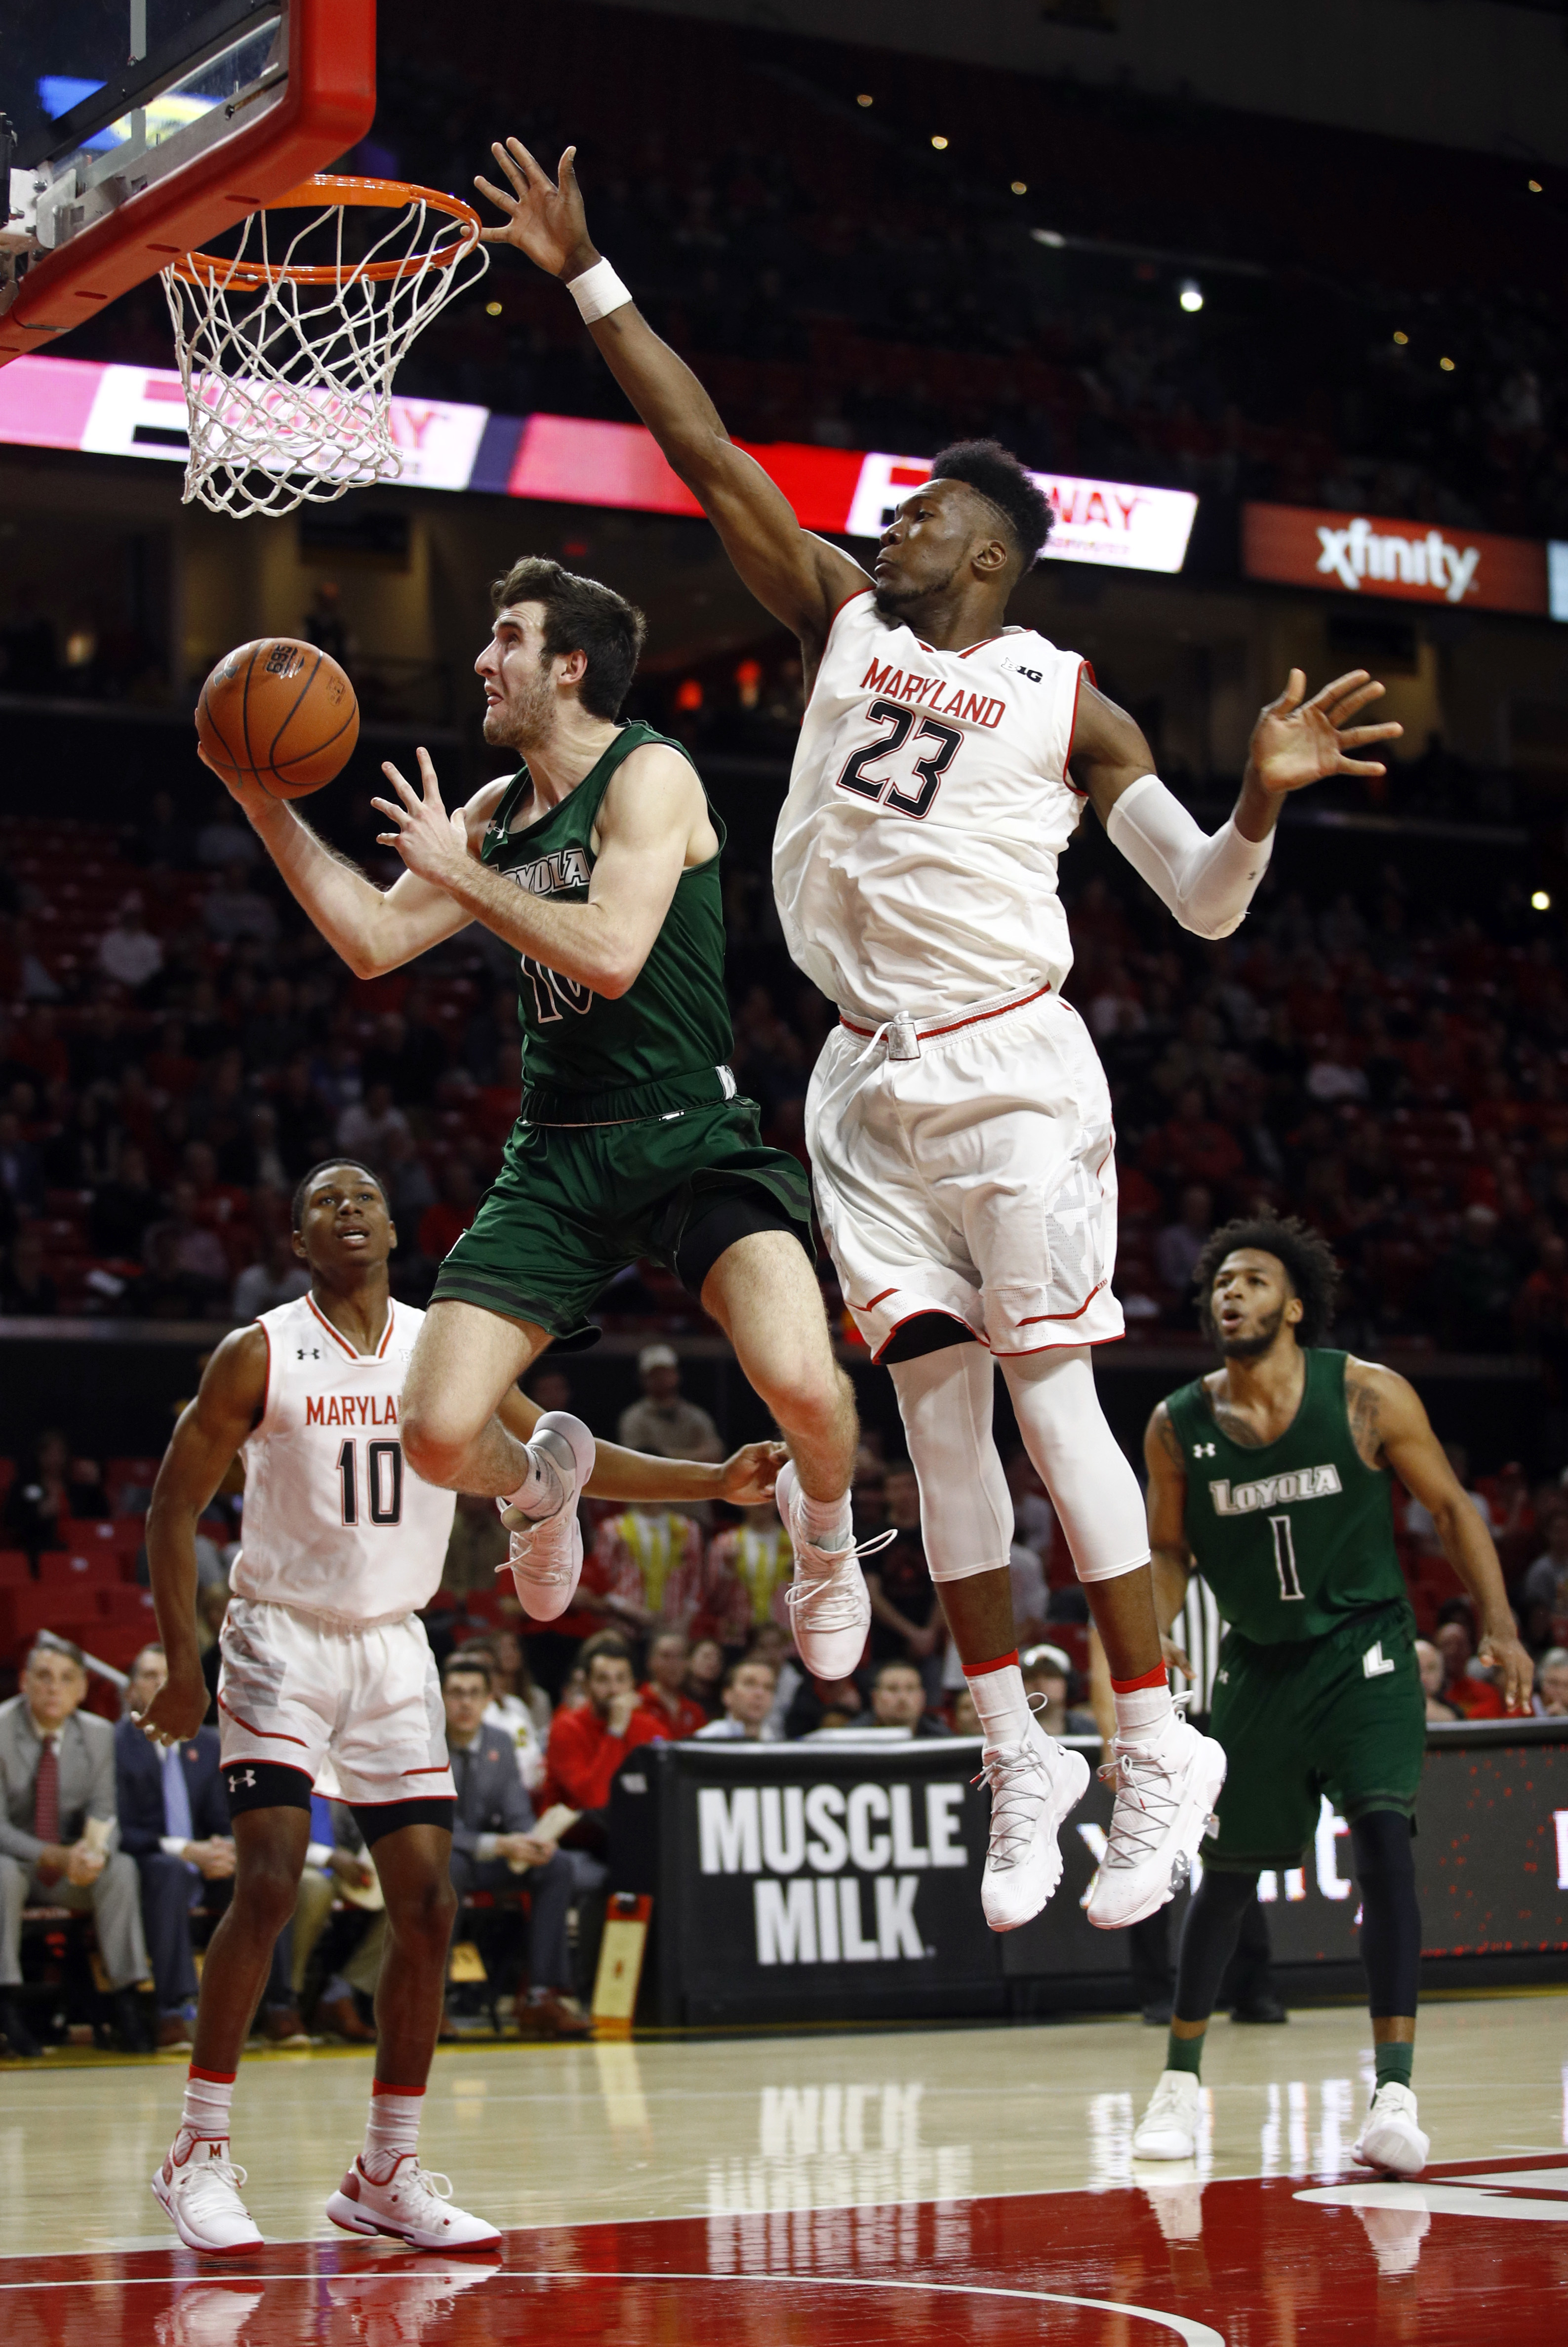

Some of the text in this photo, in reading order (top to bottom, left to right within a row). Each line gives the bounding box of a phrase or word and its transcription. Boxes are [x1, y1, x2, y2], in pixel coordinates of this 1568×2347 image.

[1316, 518, 1480, 603] xfinity
[859, 657, 1006, 729] MARYLAND
[836, 697, 965, 820] 23
[305, 1395, 401, 1426] MARYLA
[336, 1438, 404, 1526] 10
[1209, 1463, 1342, 1516] LOYOLA
[1268, 1515, 1305, 1600] 1
[697, 1782, 968, 1874] MUSCLE
[753, 1876, 926, 1966] MILK
